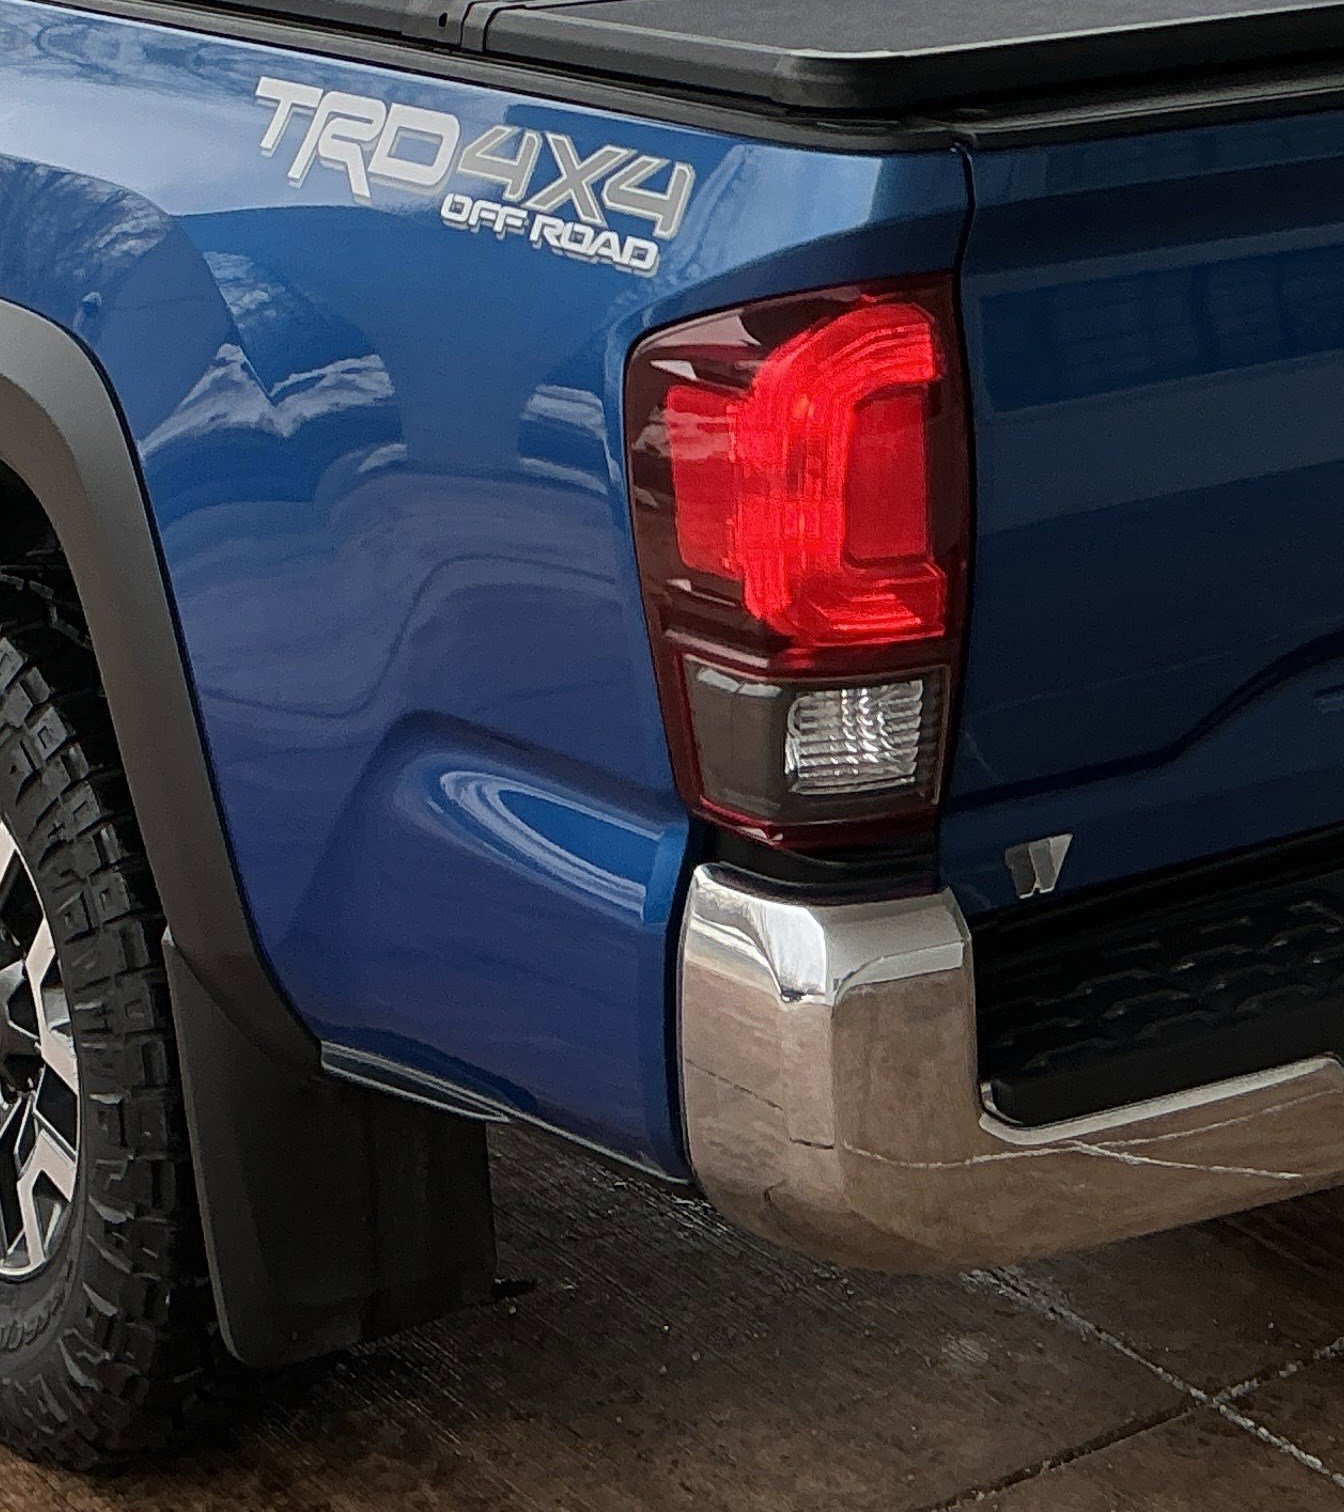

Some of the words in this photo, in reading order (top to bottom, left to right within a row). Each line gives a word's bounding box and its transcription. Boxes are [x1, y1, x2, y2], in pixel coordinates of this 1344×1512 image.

[255, 76, 460, 202] TRD
[440, 193, 528, 239] OFF
[529, 216, 661, 277] ROAD
